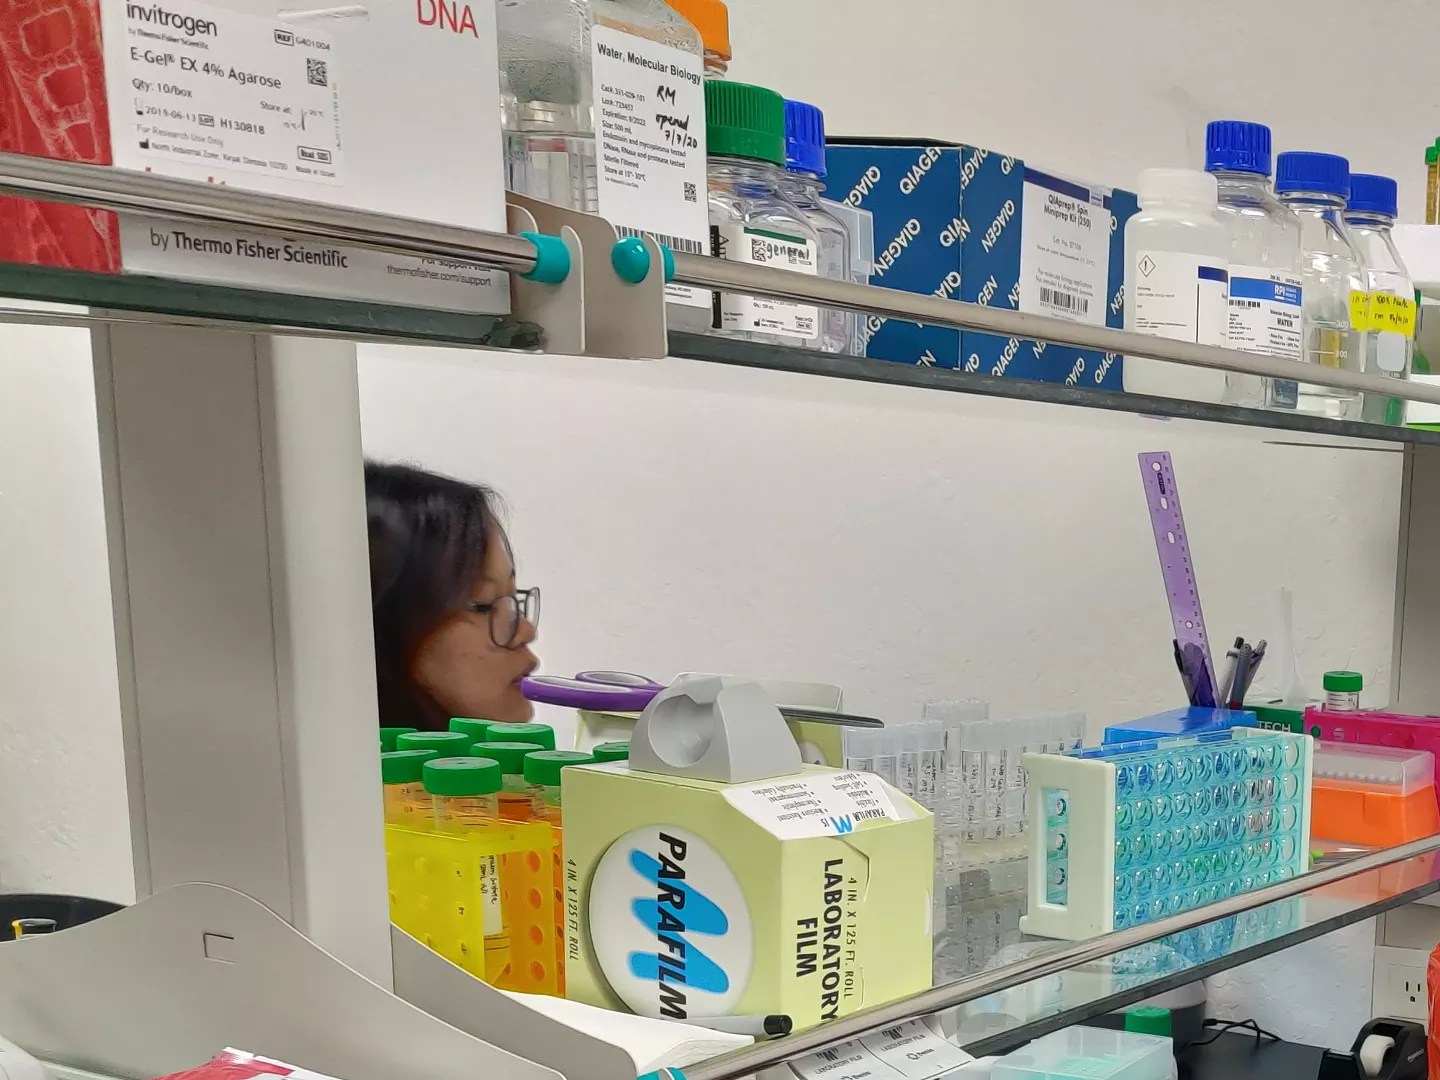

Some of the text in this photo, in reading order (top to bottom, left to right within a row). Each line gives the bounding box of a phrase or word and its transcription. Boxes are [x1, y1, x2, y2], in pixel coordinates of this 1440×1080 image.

[126, 0, 218, 36] invitrogen
[417, 0, 479, 38] DNA
[277, 33, 291, 43] REF
[180, 56, 198, 72] EX
[202, 62, 225, 77] 4%
[228, 67, 282, 89] Agarose
[597, 42, 701, 85] Water, Molecular Biology
[132, 78, 193, 98] Qty: 10/box
[656, 85, 676, 106] RM
[136, 124, 224, 148] For Research Use Only
[220, 118, 265, 135] H130818
[664, 129, 698, 148] 7/7/20
[1044, 205, 1068, 222] Miniprep
[1069, 211, 1077, 223] Kit
[1077, 204, 1088, 216] Spin
[981, 199, 1015, 254] QIAGEN
[150, 228, 348, 269] by Thermo Fisher Scientific
[766, 243, 810, 260] general
[873, 218, 921, 277] QIAGEN
[829, 814, 853, 833] M
[852, 807, 886, 822] PARAFILM
[847, 889, 857, 906] IN.
[567, 858, 579, 961] 4 IN. X 125 FT. ROLL
[657, 832, 688, 1020] PARAFILM
[846, 925, 857, 945] 125
[796, 917, 818, 978] FILM
[821, 858, 844, 1021] LABORATORY
[845, 950, 856, 966] FT.
[844, 971, 854, 1000] ROLL
[880, 1034, 926, 1052] LABORATORY FILM
[815, 1055, 863, 1075] LABORATORY FILM
